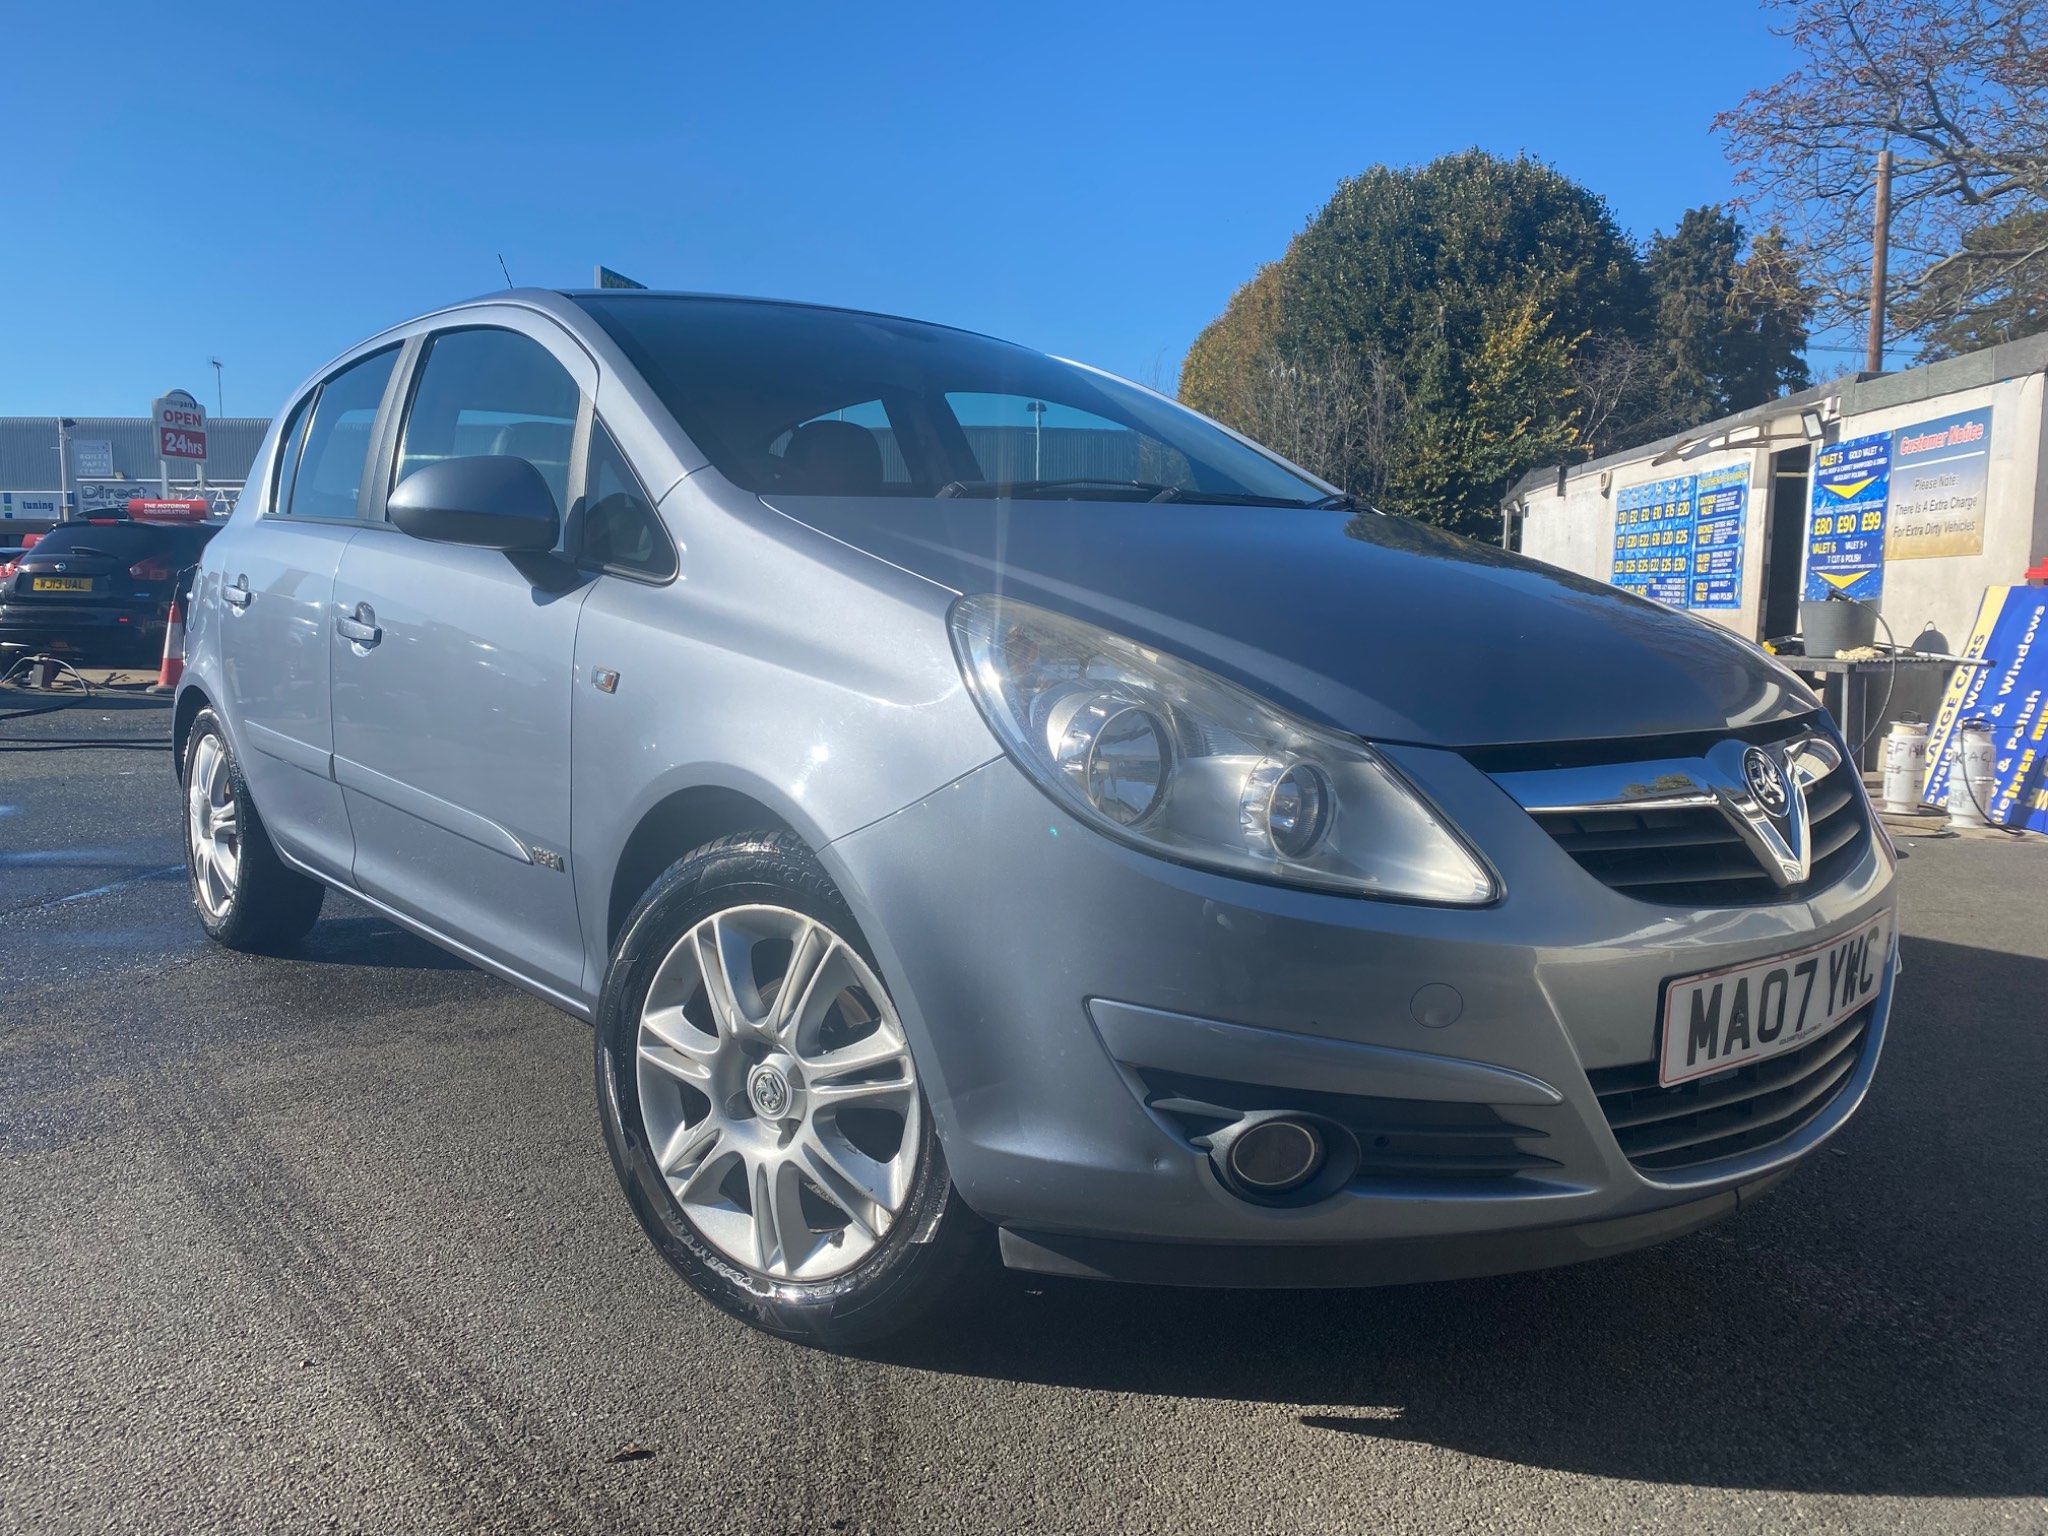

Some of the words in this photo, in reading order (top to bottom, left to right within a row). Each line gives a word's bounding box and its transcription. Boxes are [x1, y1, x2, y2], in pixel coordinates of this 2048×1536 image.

[163, 409, 202, 427] OPEN
[165, 432, 203, 455] 24hrs
[1901, 431, 1948, 455] Customer
[1948, 421, 1984, 446] Notice
[1820, 453, 1838, 467] VALET
[1838, 451, 1844, 464] 5
[1849, 449, 1863, 460] GOLD
[82, 484, 146, 499] Direct
[1914, 477, 1938, 491] Please
[1939, 474, 1960, 486] Note:
[22, 501, 54, 511] tuning
[1895, 503, 1914, 516] There
[1914, 502, 1921, 514] Is
[1922, 501, 1928, 512] A
[1929, 498, 1949, 512] Extra
[1950, 496, 1977, 511] Charge
[1814, 517, 1833, 536] £80
[1837, 514, 1857, 534] £90
[1861, 510, 1882, 532] £99
[1893, 524, 1906, 538] For
[1906, 522, 1924, 537] Extra
[1925, 520, 1943, 537] Dirty
[1944, 519, 1976, 534] Vehicles
[1675, 529, 1688, 544] £25
[1845, 541, 1859, 550] VALET
[1813, 542, 1831, 554] VALET
[1845, 553, 1861, 563] POLISH
[1998, 605, 2046, 696] Windows
[1963, 668, 1990, 710] Wax
[1925, 695, 1959, 770] LARGE
[1955, 633, 1986, 690] CARS
[1991, 702, 2007, 717] &
[1997, 758, 2013, 773] &
[2005, 690, 2042, 751] Polish
[1686, 957, 1819, 1067] MA07
[1827, 926, 1880, 1016] YWC
